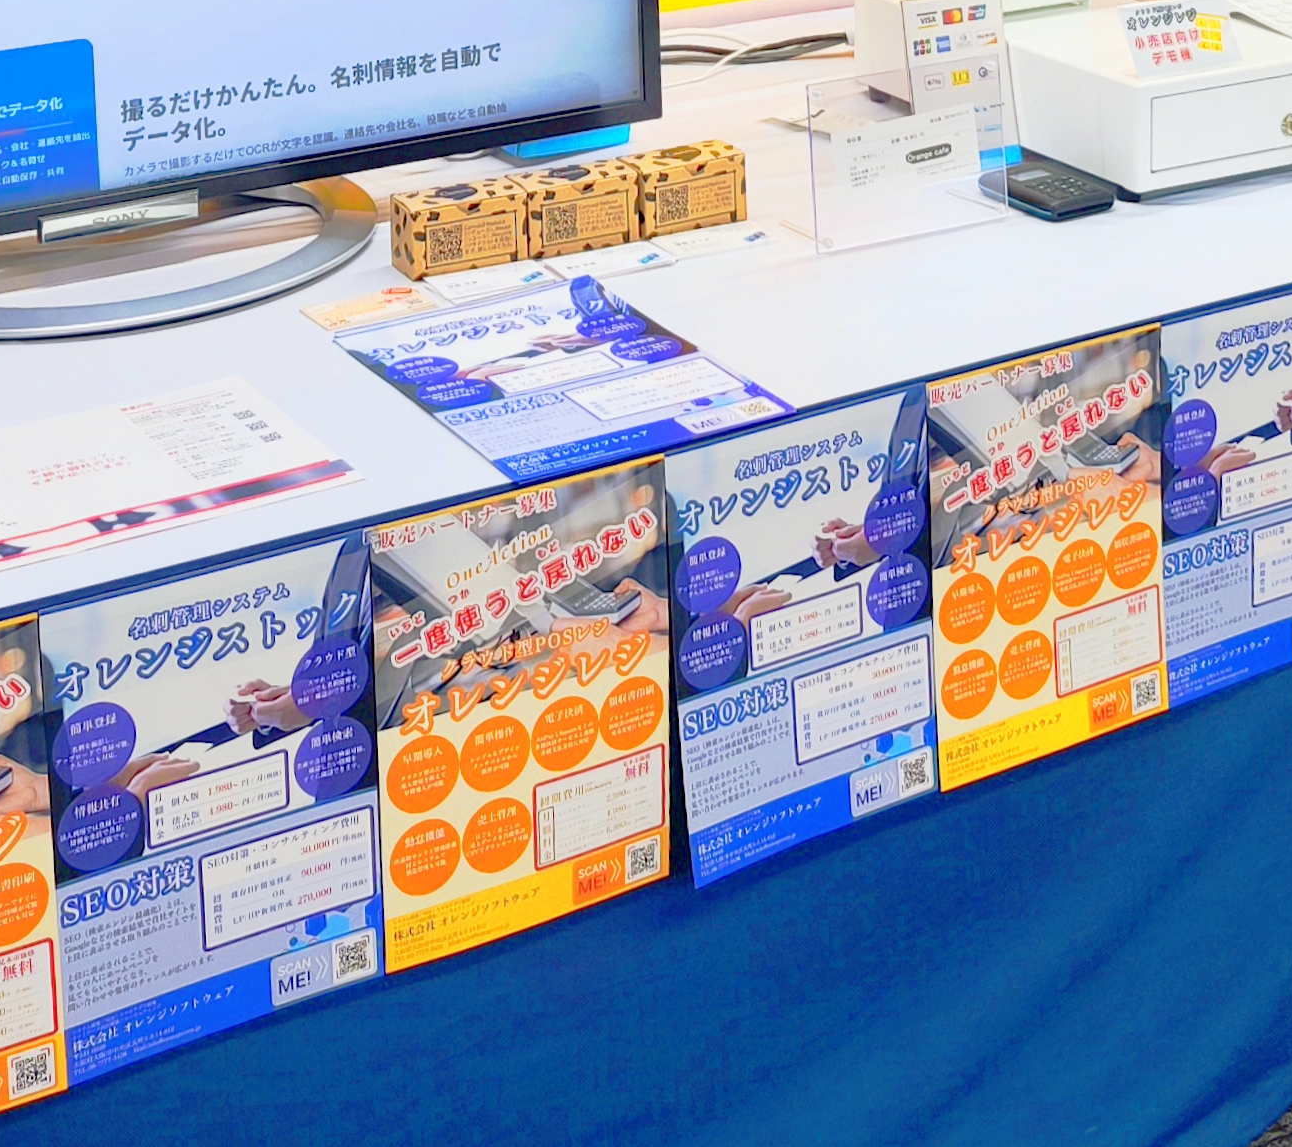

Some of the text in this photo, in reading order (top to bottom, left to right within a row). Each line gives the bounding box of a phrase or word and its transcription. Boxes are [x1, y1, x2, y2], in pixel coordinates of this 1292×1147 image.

[919, 16, 937, 25] VISA
[122, 114, 227, 151] データ化。
[92, 209, 151, 226] SONY
[676, 436, 915, 539] オレンジストック
[950, 475, 1145, 577] オレンジレジ
[1162, 526, 1249, 580] SEO対策
[54, 587, 357, 706] オレンジストック
[400, 626, 649, 740] オレンジレジ
[681, 675, 788, 742] SEO対策
[59, 853, 195, 929] SEO対策
[277, 969, 311, 996] ME!
